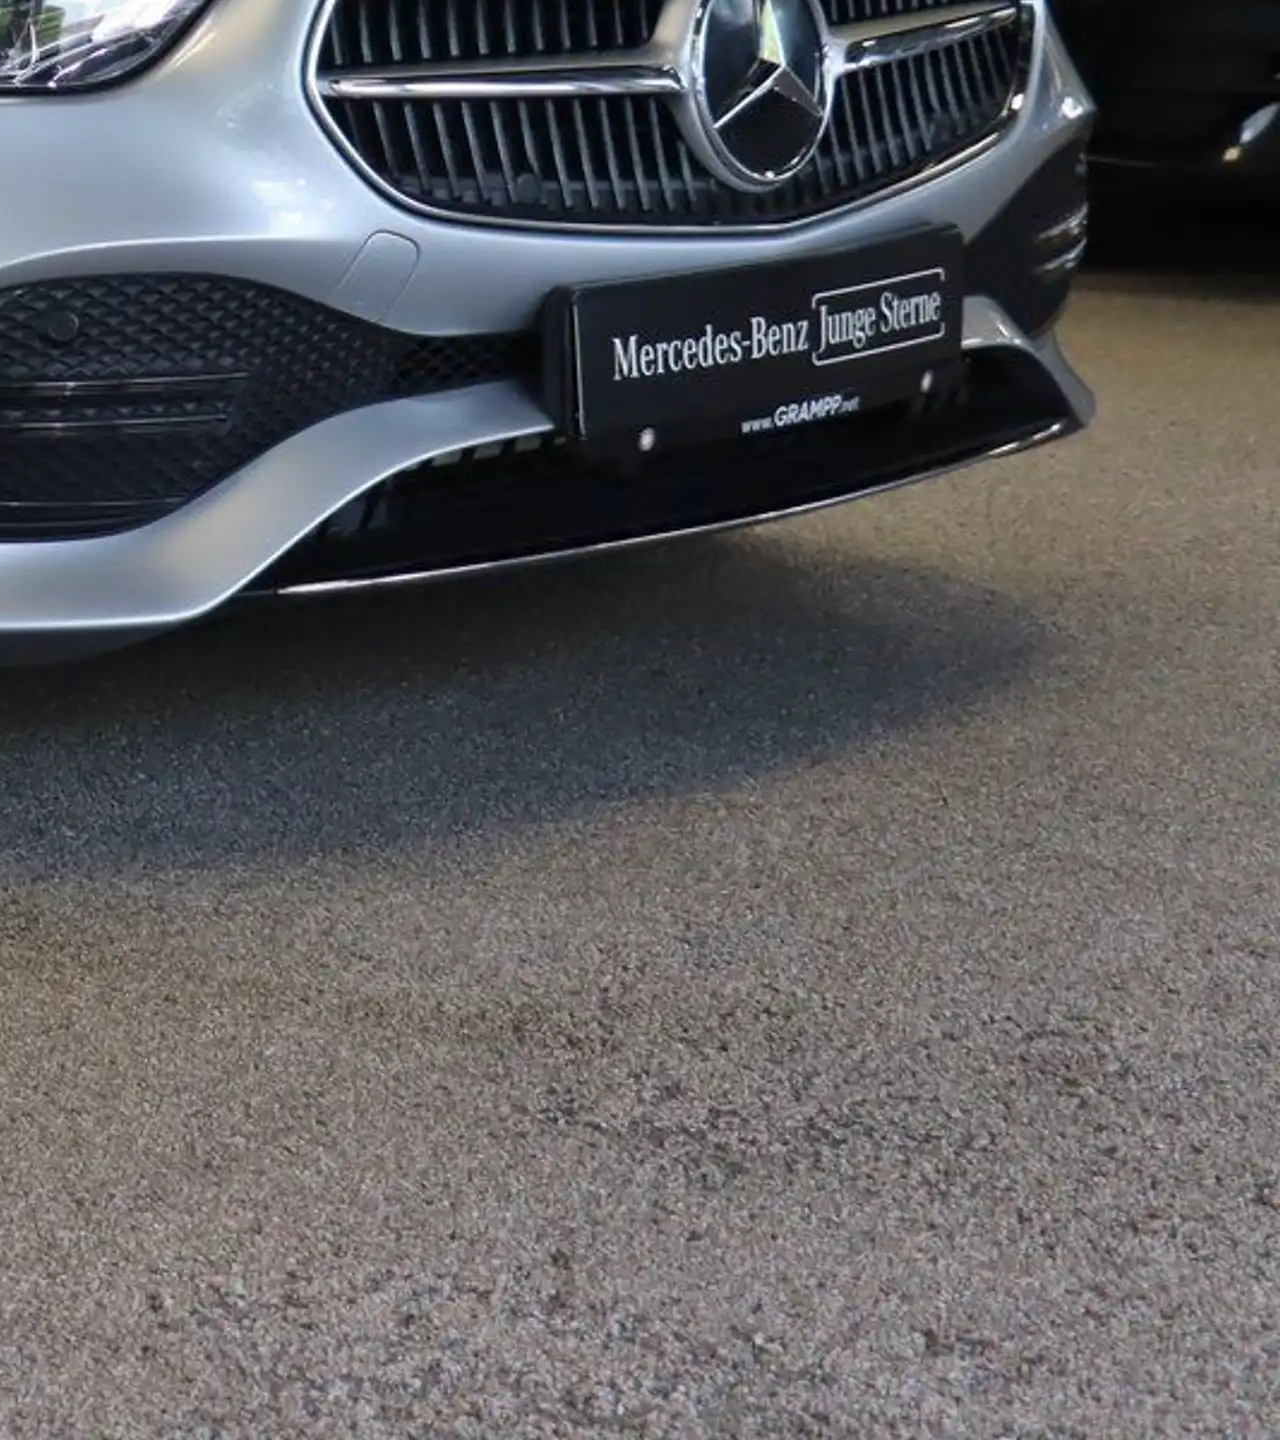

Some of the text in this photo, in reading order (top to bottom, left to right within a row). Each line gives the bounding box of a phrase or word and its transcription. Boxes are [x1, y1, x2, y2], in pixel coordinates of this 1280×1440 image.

[613, 291, 941, 380] Mercedes-Benz Junge Sterne
